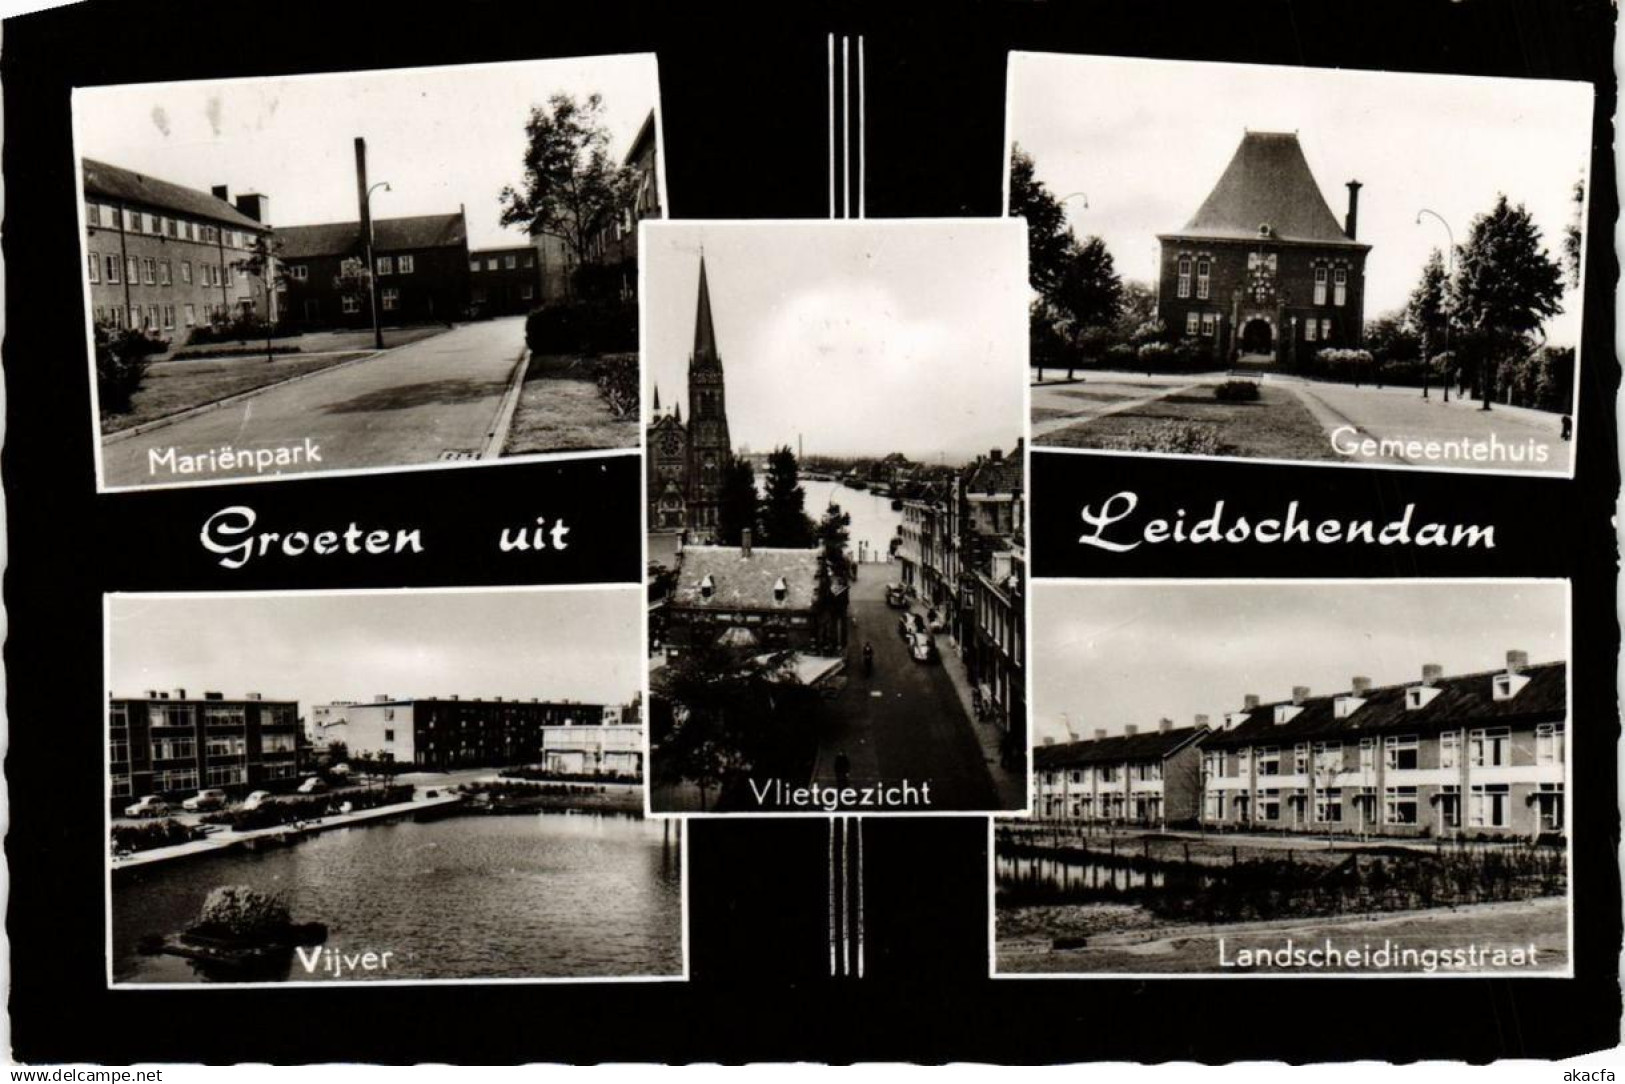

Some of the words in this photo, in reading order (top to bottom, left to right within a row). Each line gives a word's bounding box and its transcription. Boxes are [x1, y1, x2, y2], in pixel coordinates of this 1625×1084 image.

[148, 438, 321, 473] Mariënpark
[1331, 425, 1549, 463] Gemeentehuis
[200, 506, 424, 568] Groeten
[499, 517, 570, 551] uit
[1078, 491, 1496, 551] Leidschendam
[749, 778, 931, 810] Vlietgezicht
[296, 945, 393, 977] Vijver
[1218, 939, 1538, 971] Landscheidingsstraat
